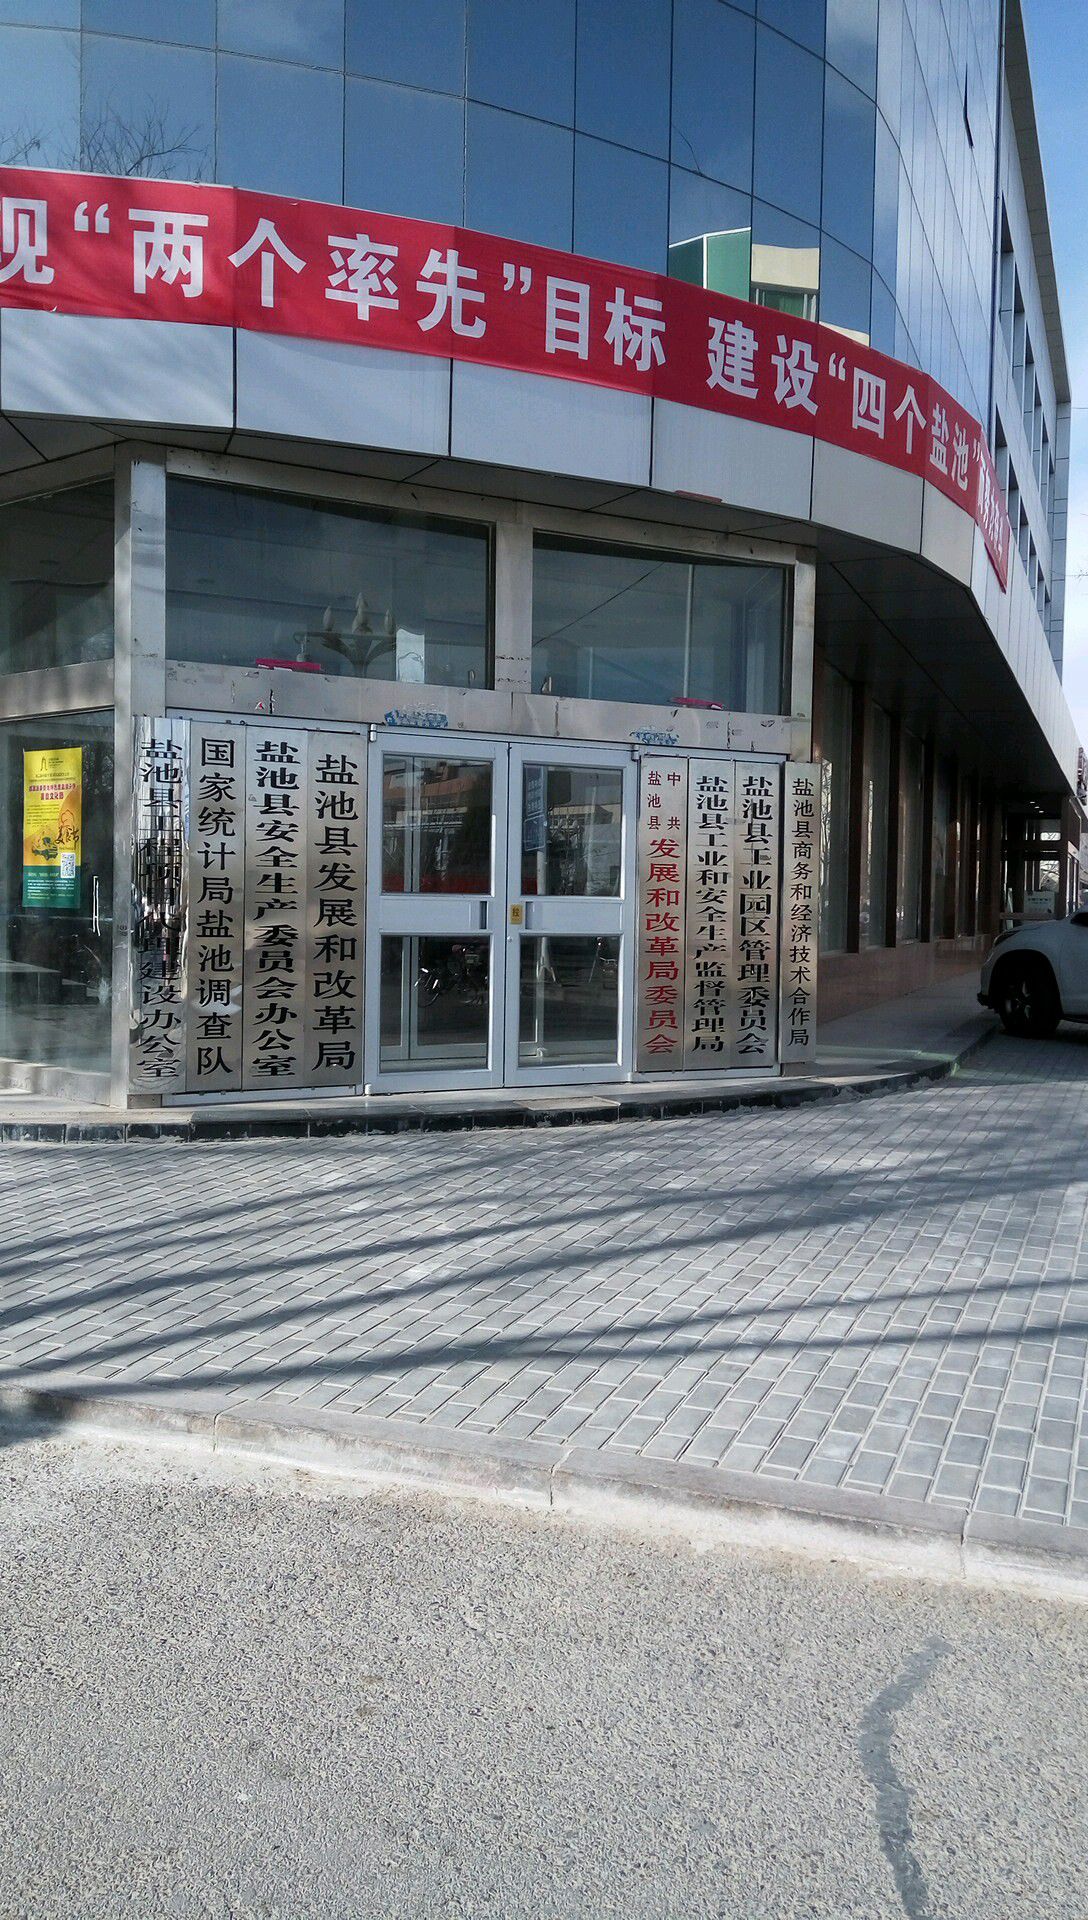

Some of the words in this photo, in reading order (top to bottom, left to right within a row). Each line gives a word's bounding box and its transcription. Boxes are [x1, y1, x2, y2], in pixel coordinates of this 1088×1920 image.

[196, 737, 237, 1076] 国家统计局盐池调查队
[252, 740, 300, 1077] 盐池县安全生产委员会办公室
[311, 754, 359, 1072] 盐池县发展和改革局
[647, 771, 662, 831] 盐池县
[667, 772, 681, 831] 中共
[692, 776, 729, 1053] 盐池县工业和安全生产监督管理局
[736, 775, 773, 1055] 盐池县工业园区管理委员会
[788, 778, 814, 1046] 盐池县商务和经济技术合作局
[645, 838, 681, 1055] 发展和改革局委员会
